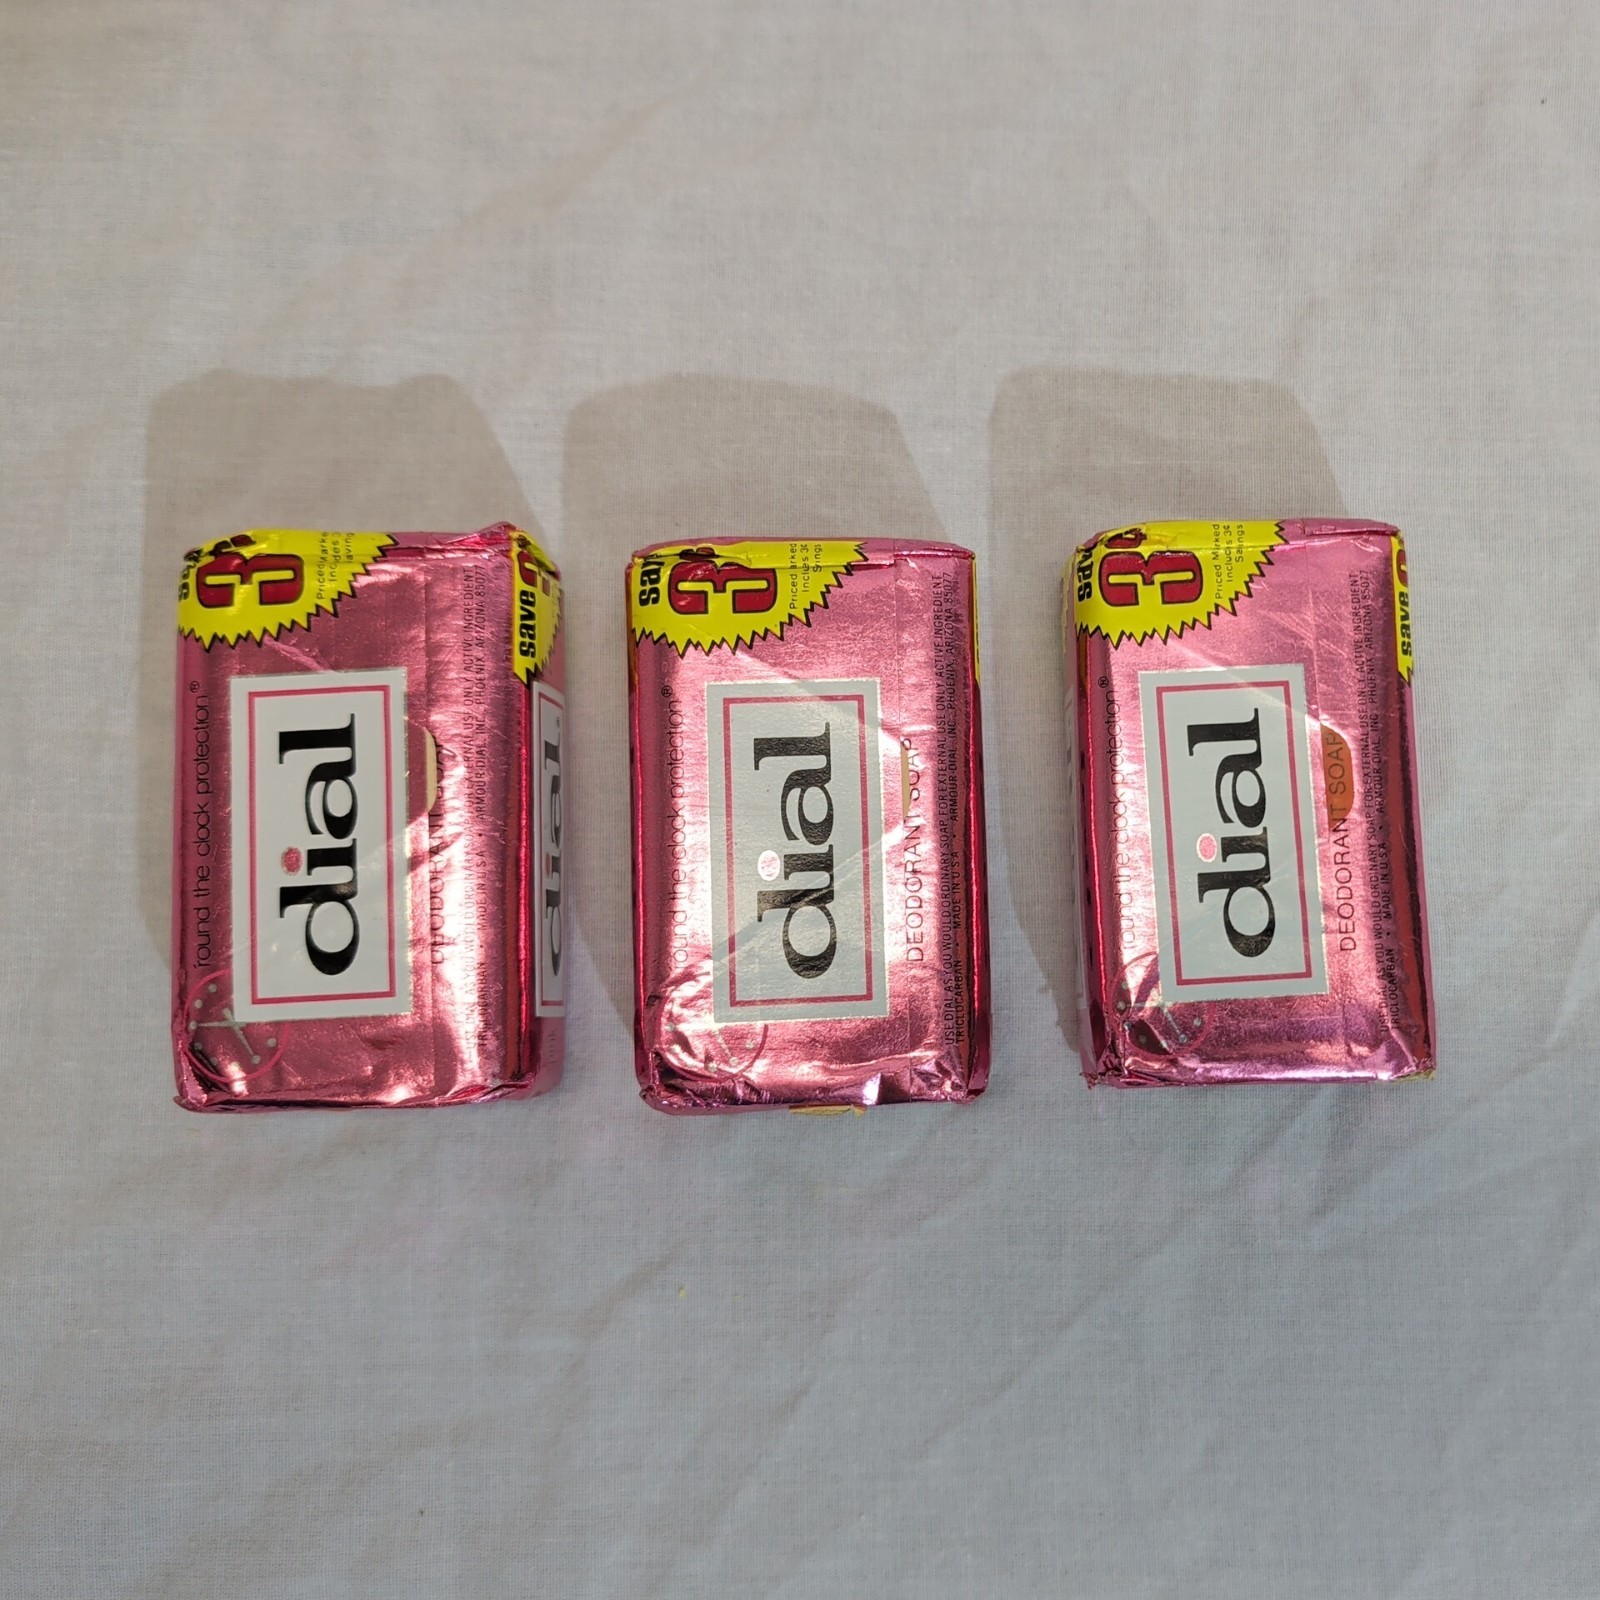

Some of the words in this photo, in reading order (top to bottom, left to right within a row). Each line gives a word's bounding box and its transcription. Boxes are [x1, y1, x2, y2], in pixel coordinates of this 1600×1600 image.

[787, 543, 799, 570] arked
[1211, 523, 1222, 561] Mrked
[316, 564, 327, 600] Priced
[474, 564, 486, 597] 85077
[788, 573, 799, 610] Priced
[941, 571, 953, 604] 85077
[1213, 564, 1226, 600] Priced
[1359, 569, 1371, 601] 85077
[474, 599, 486, 649] ARIZONA
[518, 589, 537, 659] save
[943, 607, 955, 655] ARIZONA
[1362, 603, 1374, 650] ARIZONA
[1397, 590, 1412, 658] save
[933, 638, 945, 678] ACTIVE
[1353, 638, 1366, 673] ACTIVE
[936, 714, 947, 734] USE
[1358, 708, 1369, 728] USE
[937, 737, 949, 792] EXTERNAL
[1326, 731, 1347, 796] SOAP
[1360, 730, 1372, 785] EXTERNAL
[938, 794, 949, 816] FOR
[1362, 787, 1374, 808] FOR
[193, 800, 211, 858] clock
[666, 805, 687, 861] clock
[1109, 793, 1130, 845] clock
[1186, 707, 1276, 958] dial
[277, 712, 361, 977] dial
[753, 722, 837, 980] dial
[193, 865, 211, 898] the
[462, 851, 475, 909] ORDINARY
[667, 868, 687, 901] the
[940, 852, 951, 908] ORDINARY
[1112, 853, 1132, 884] the
[1329, 804, 1357, 952] DEODORANT
[1367, 843, 1380, 899] ORDINARY
[1380, 873, 1390, 885] IN
[475, 882, 487, 894] IN
[903, 814, 924, 962] DEODORANT
[951, 882, 961, 894] IN
[1380, 889, 1393, 919] MADE
[476, 899, 487, 931] MADE
[941, 910, 952, 951] WOULD
[951, 899, 962, 930] MADE
[1371, 900, 1383, 940] WOULD
[463, 956, 475, 980] YOU
[942, 954, 953, 976] YOU
[1374, 942, 1385, 965] YOU
[463, 981, 477, 995] AS
[942, 978, 953, 992] AS
[1376, 967, 1387, 981] AS
[1385, 948, 1400, 1029] TRICLOCARBAN
[943, 996, 955, 1021] DIAL
[953, 959, 965, 1045] TRICLOCARBAN
[1377, 984, 1389, 1009] DIAL
[944, 1024, 955, 1046] USE
[1378, 1011, 1390, 1033] USE
